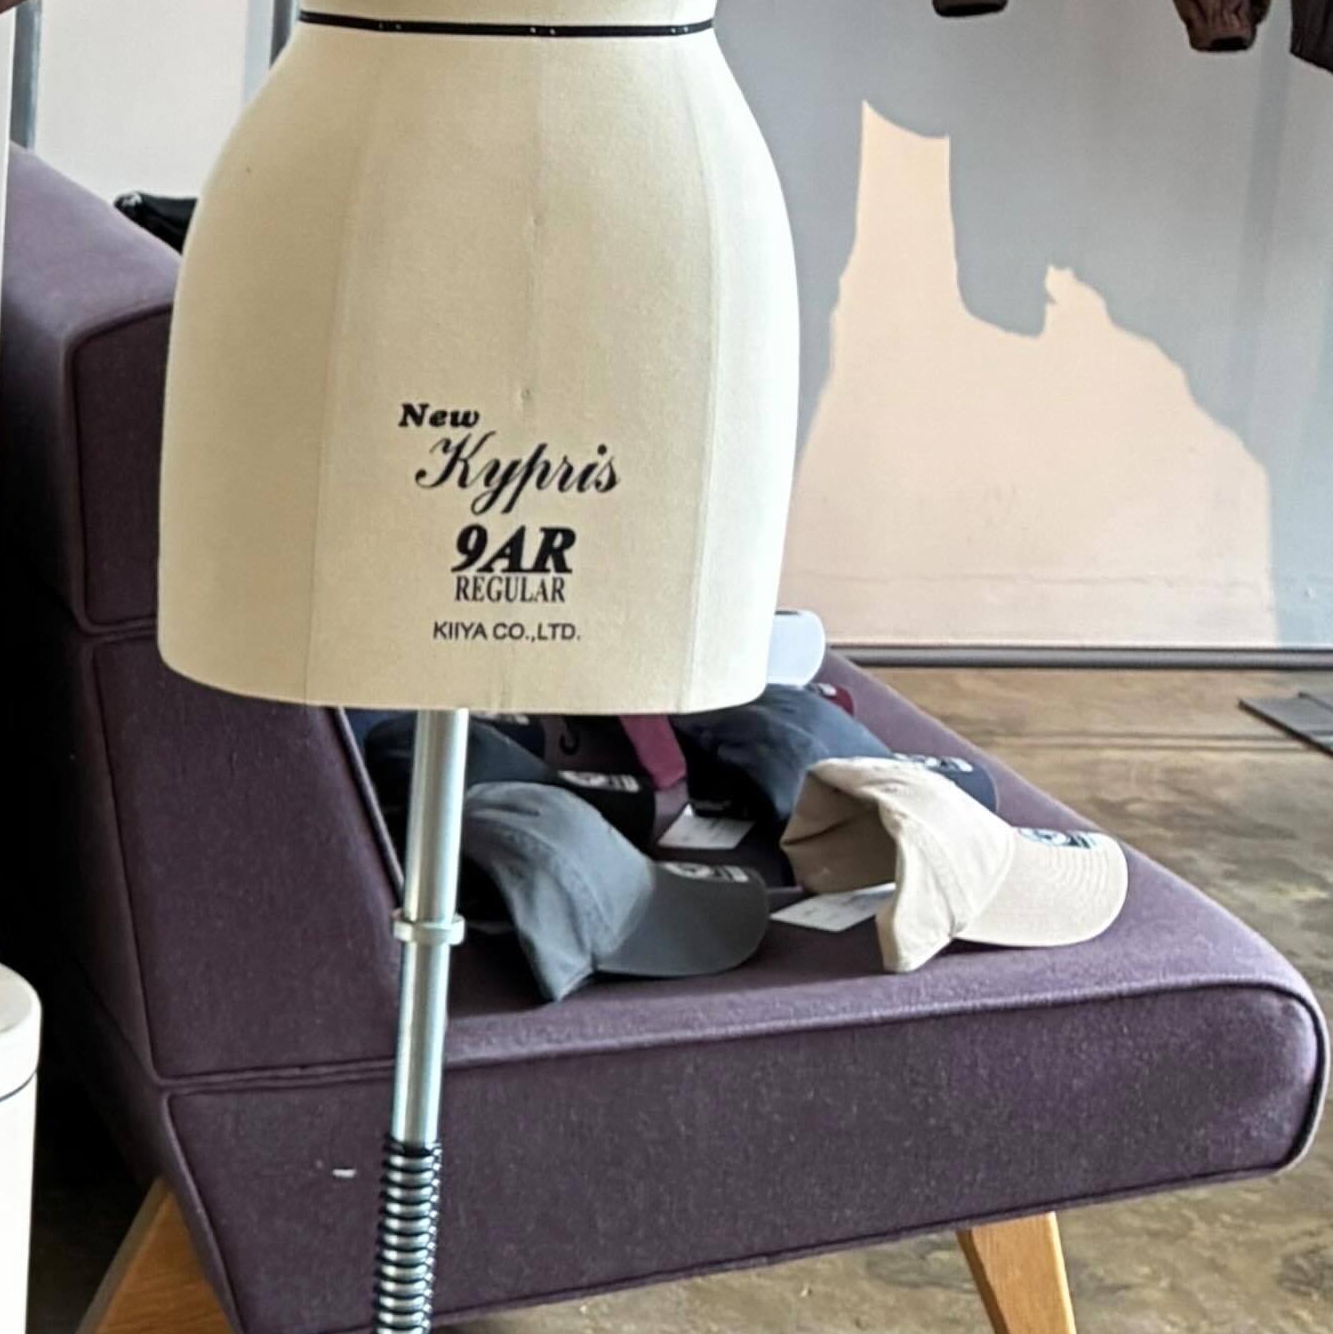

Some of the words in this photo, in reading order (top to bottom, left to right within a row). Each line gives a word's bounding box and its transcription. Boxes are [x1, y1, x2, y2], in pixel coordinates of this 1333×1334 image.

[398, 402, 480, 429] New
[414, 430, 620, 516] Kypris
[450, 522, 577, 575] 9AR
[454, 575, 566, 604] REGULAR
[432, 620, 488, 641] KIIYA
